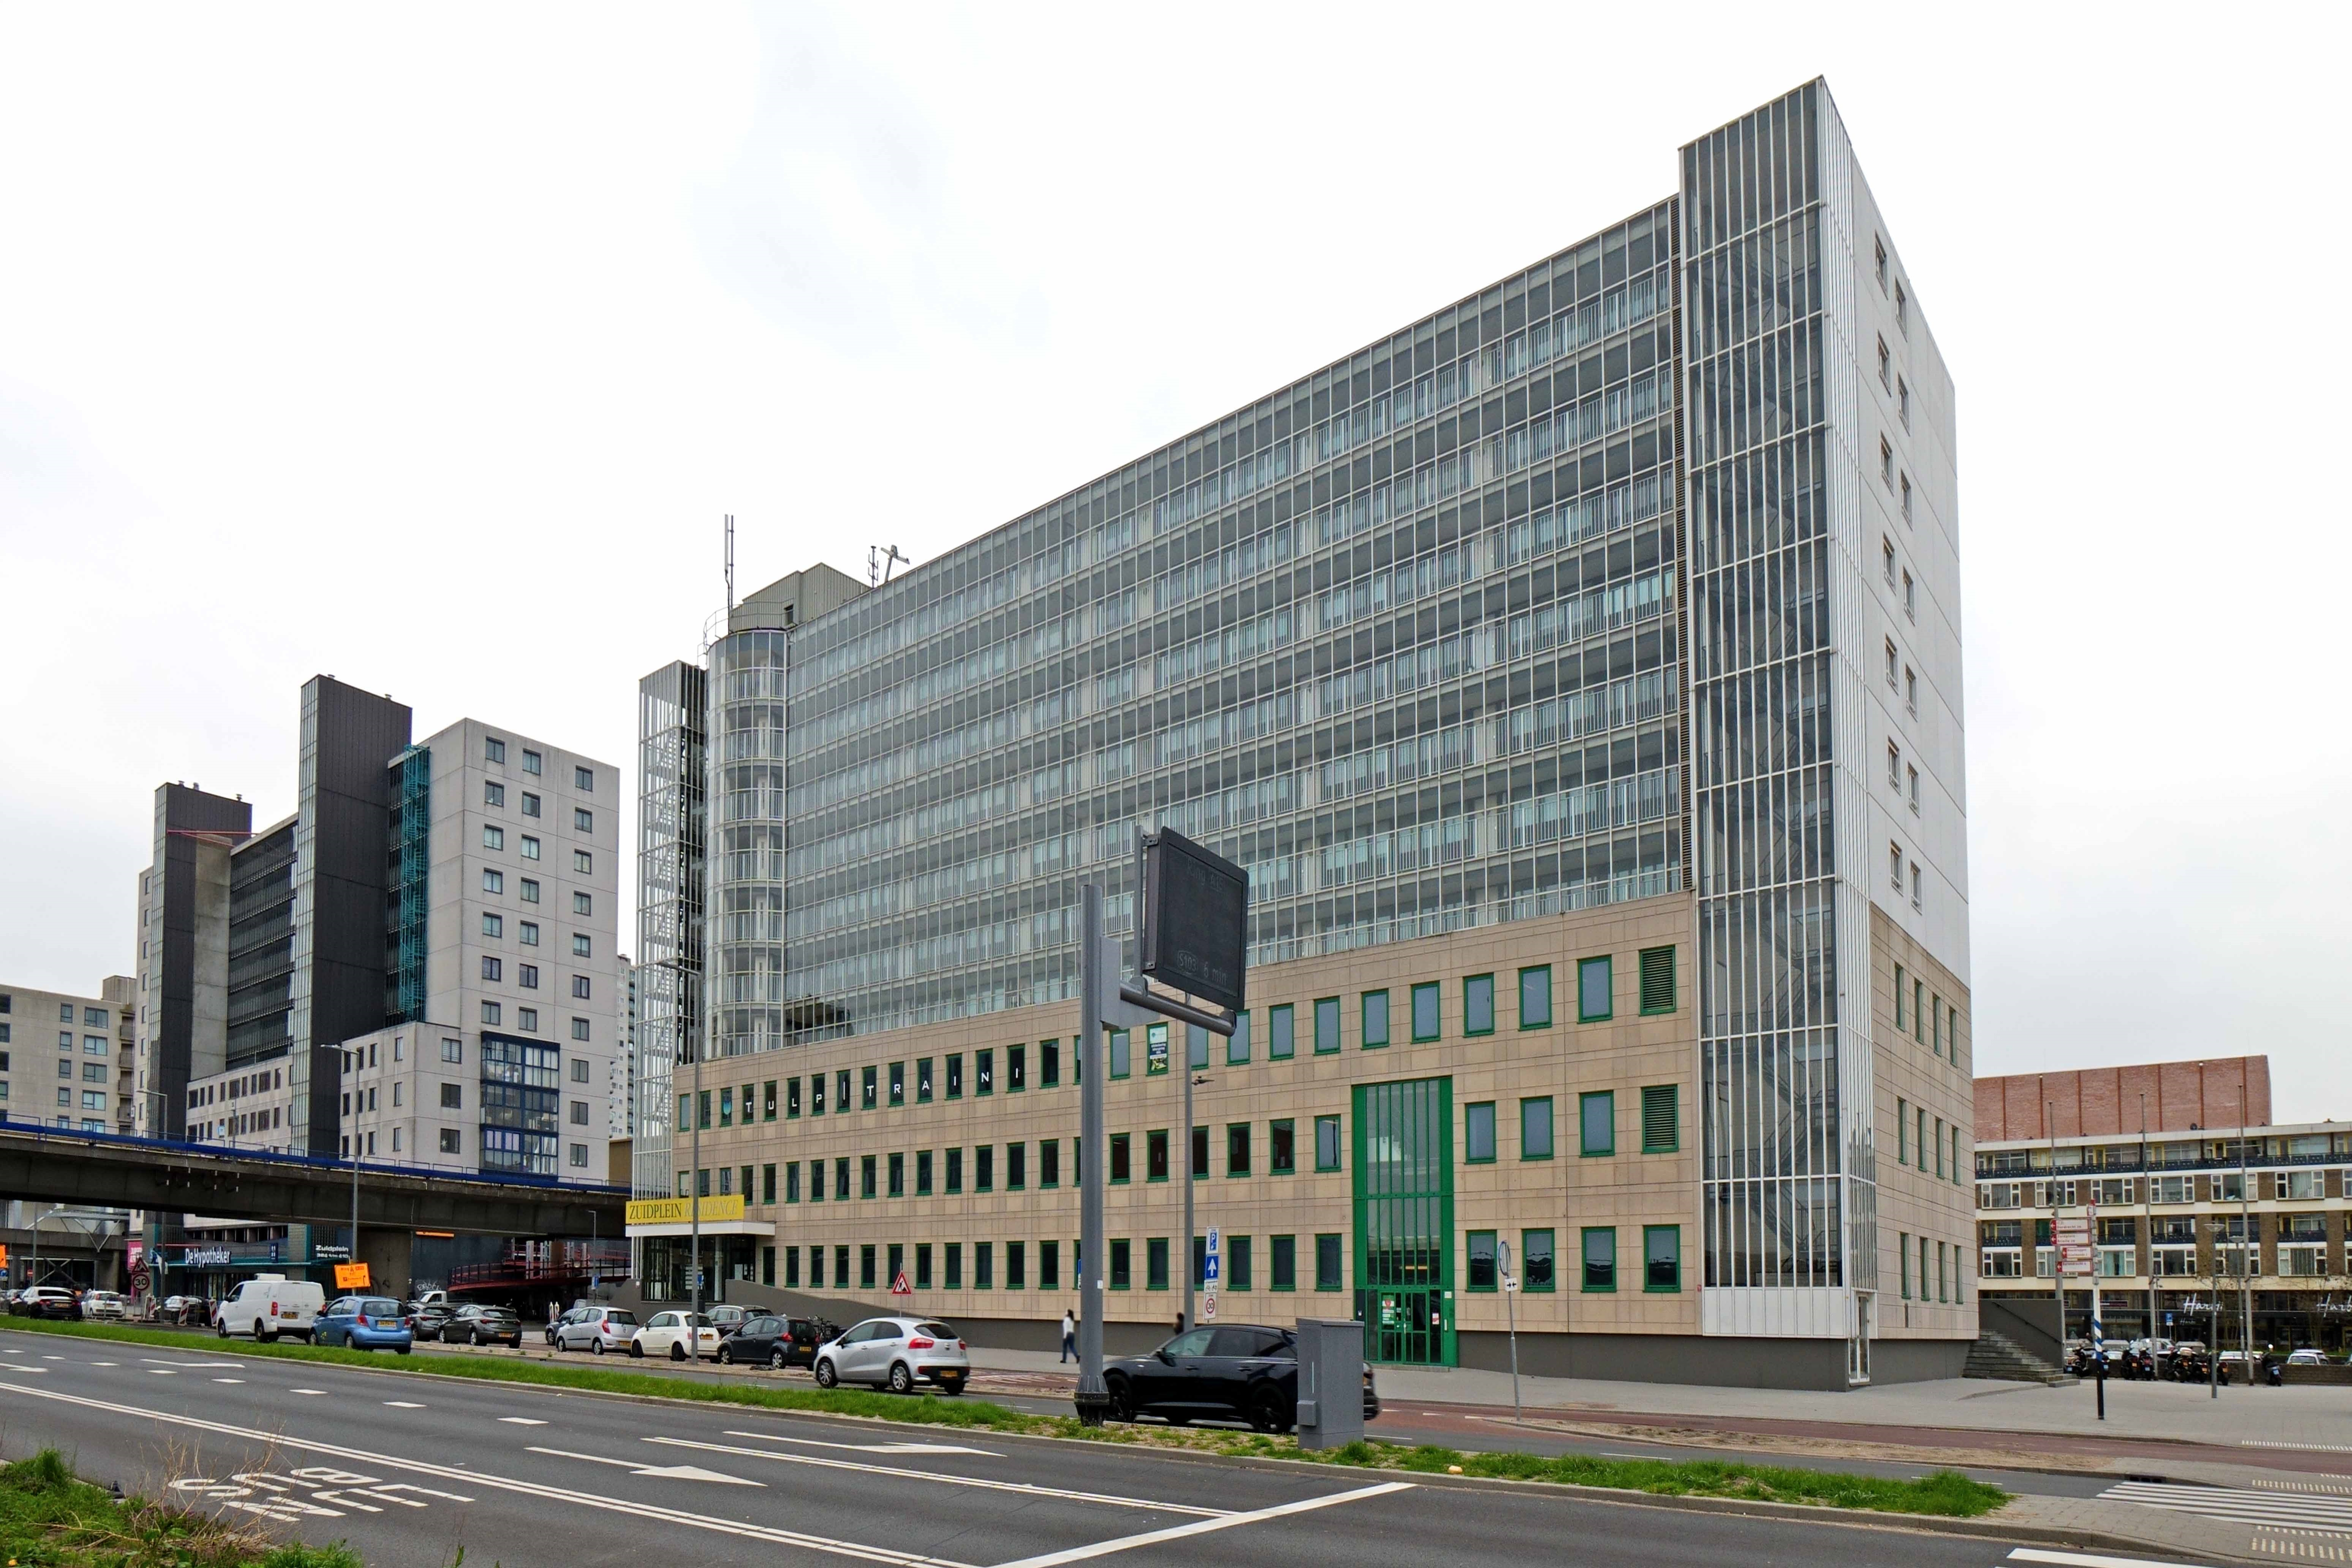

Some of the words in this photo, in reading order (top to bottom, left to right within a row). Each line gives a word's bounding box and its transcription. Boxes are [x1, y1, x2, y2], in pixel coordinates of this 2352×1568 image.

[1179, 953, 1196, 972] S103
[1212, 967, 1226, 986] min
[745, 1094, 822, 1113] TULP
[629, 1203, 682, 1219] ZUIDPLEIN
[684, 1200, 738, 1217] RSIDENCE
[185, 1248, 194, 1264] De
[194, 1246, 231, 1268] Hypotheker
[168, 1467, 383, 1497] BUS
